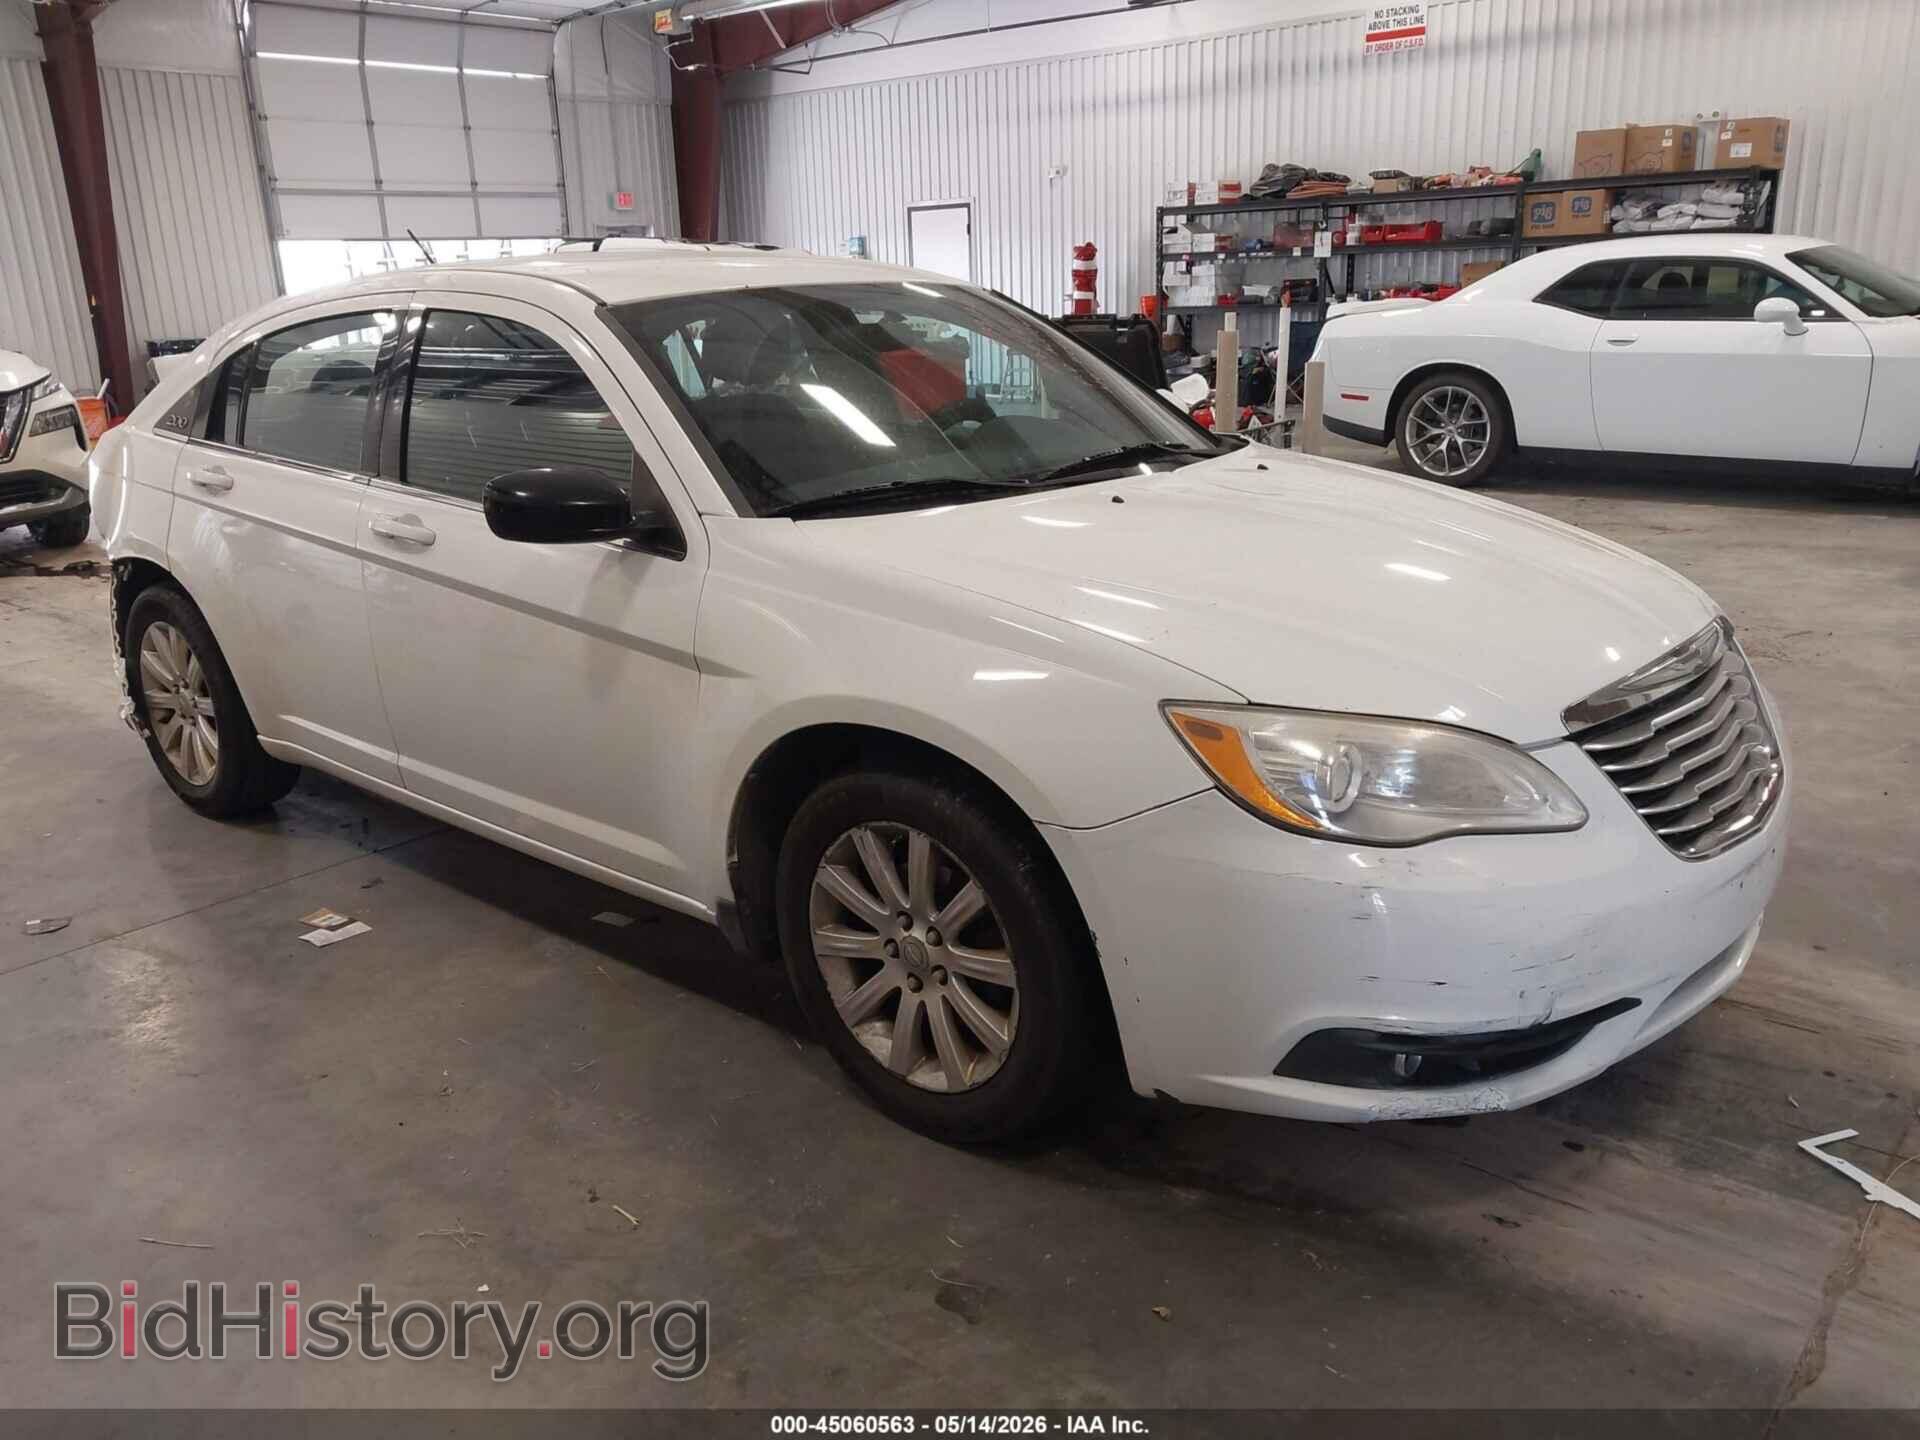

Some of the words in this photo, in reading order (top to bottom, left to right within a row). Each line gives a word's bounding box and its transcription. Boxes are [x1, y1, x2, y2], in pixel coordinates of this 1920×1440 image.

[1374, 9, 1384, 19] NO
[1385, 4, 1420, 18] STACKING
[1368, 19, 1391, 31] ABOVE
[1392, 17, 1408, 28] THIS
[1409, 14, 1425, 26] LINE
